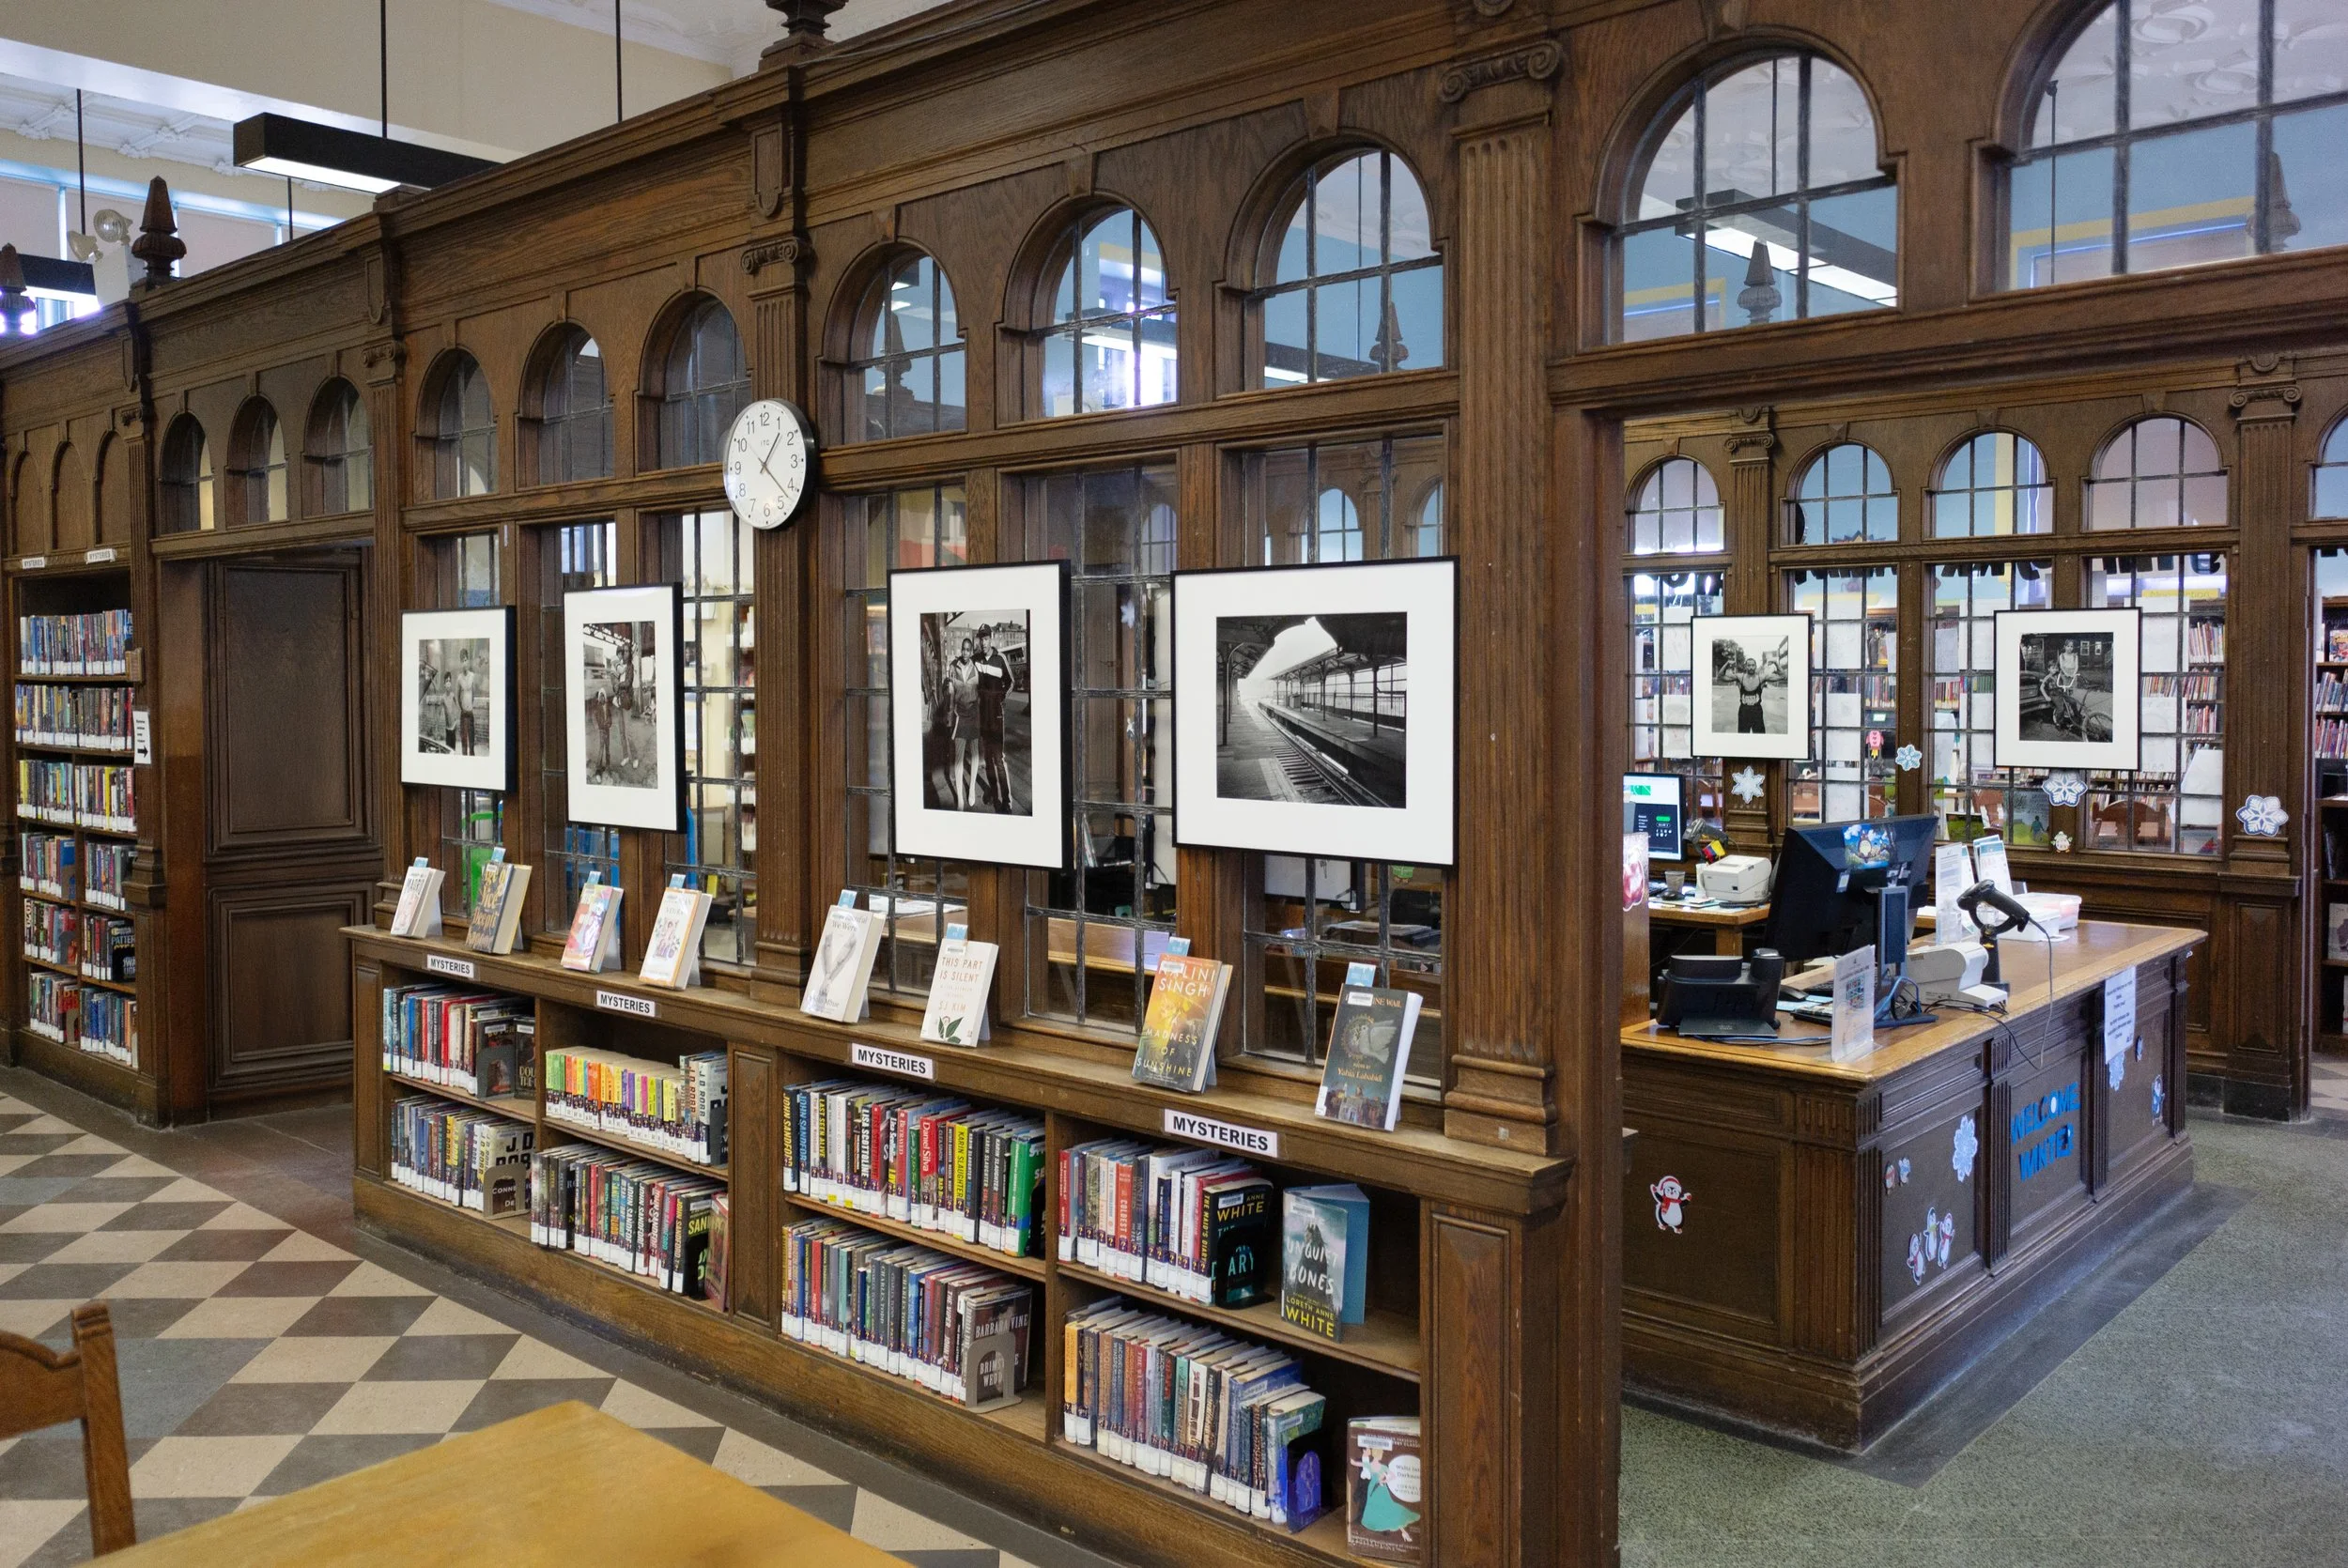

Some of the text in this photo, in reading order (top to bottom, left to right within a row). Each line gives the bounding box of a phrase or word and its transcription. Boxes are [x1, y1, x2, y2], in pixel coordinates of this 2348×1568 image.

[759, 411, 770, 426] 12
[776, 417, 780, 430] 1
[748, 421, 755, 435] 11
[737, 438, 748, 453] 10
[787, 432, 795, 446] 2
[734, 461, 742, 475] 9
[791, 454, 798, 469] 3
[739, 483, 746, 497] 8
[787, 478, 795, 491] 4
[749, 499, 757, 512] 7
[764, 503, 771, 517] 6
[778, 496, 785, 509] 5
[842, 922, 857, 932] Were
[430, 958, 471, 975] MYSTERIES
[941, 957, 983, 971] THIS PART
[939, 972, 980, 982] IS SILENT
[1159, 977, 1208, 998] SINGH
[601, 994, 651, 1013] MYSTERIES
[938, 1001, 966, 1012] SJ KIM
[1172, 1014, 1178, 1025] A
[1146, 1028, 1198, 1046] MADNESS
[1161, 1046, 1176, 1056] OF
[857, 1049, 927, 1074] MYSTERIES
[1136, 1057, 1194, 1077] SUNSHINE
[799, 1093, 808, 1118] JOHN
[2010, 1082, 2081, 1145] WELCOME
[1173, 1115, 1269, 1151] MYSTERIES
[505, 1131, 535, 1153] J. D.
[861, 1129, 870, 1178] SCOTTOLINE
[922, 1150, 931, 1172] Silva
[2018, 1123, 2075, 1182] WINTER
[496, 1152, 531, 1171] ROB
[1246, 1194, 1264, 1203] ANNE
[649, 1187, 660, 1249] JOHN SANDFOR
[1120, 1199, 1128, 1234] COLDEST
[1217, 1202, 1264, 1222] WHITE
[1287, 1237, 1338, 1268] UNQUIET
[1290, 1267, 1335, 1295] BONES
[1287, 1296, 1335, 1320] LORETH ANNE
[975, 1314, 1028, 1339] BARBARA VINE
[1285, 1306, 1335, 1337] WHITE
[983, 1371, 1003, 1387] WEDD
